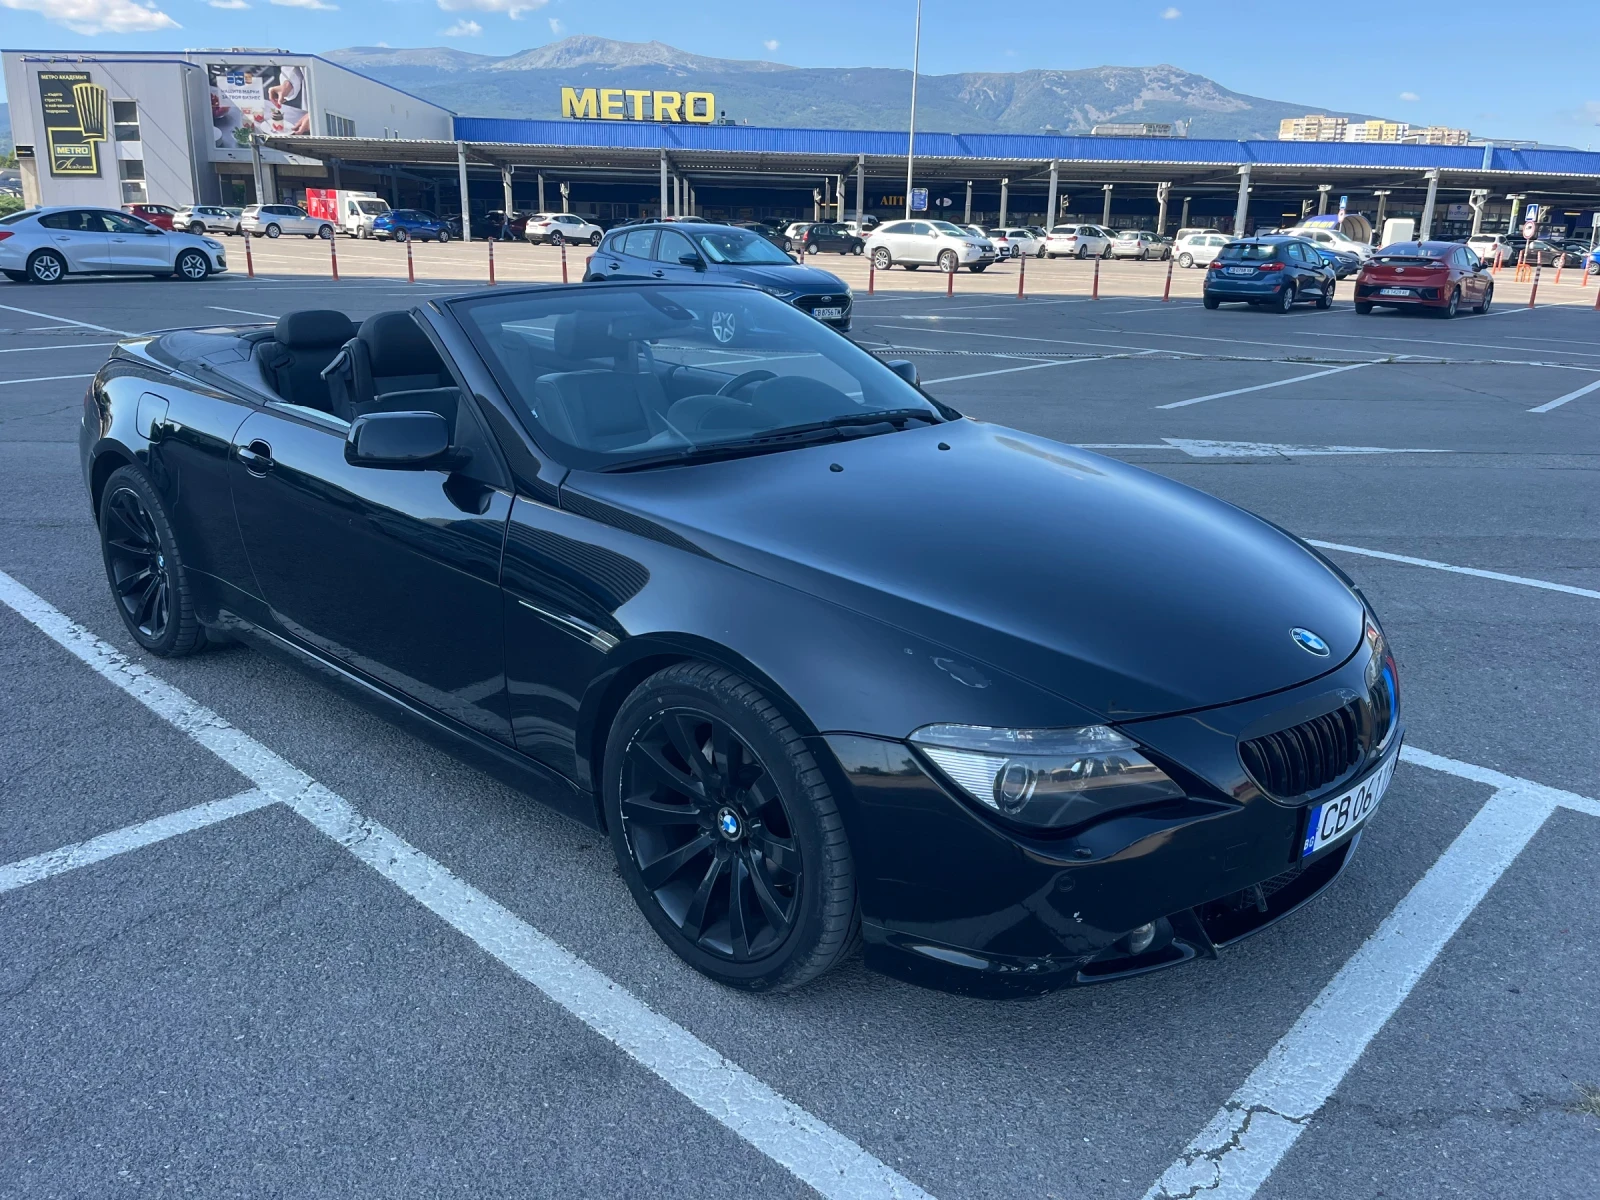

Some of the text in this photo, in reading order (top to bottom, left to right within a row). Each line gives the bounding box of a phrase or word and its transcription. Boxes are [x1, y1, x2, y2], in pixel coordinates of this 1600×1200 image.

[561, 87, 715, 123] METRO
[881, 196, 905, 205] АПТ
[1320, 795, 1351, 841] CB
[1303, 836, 1315, 850] BG
